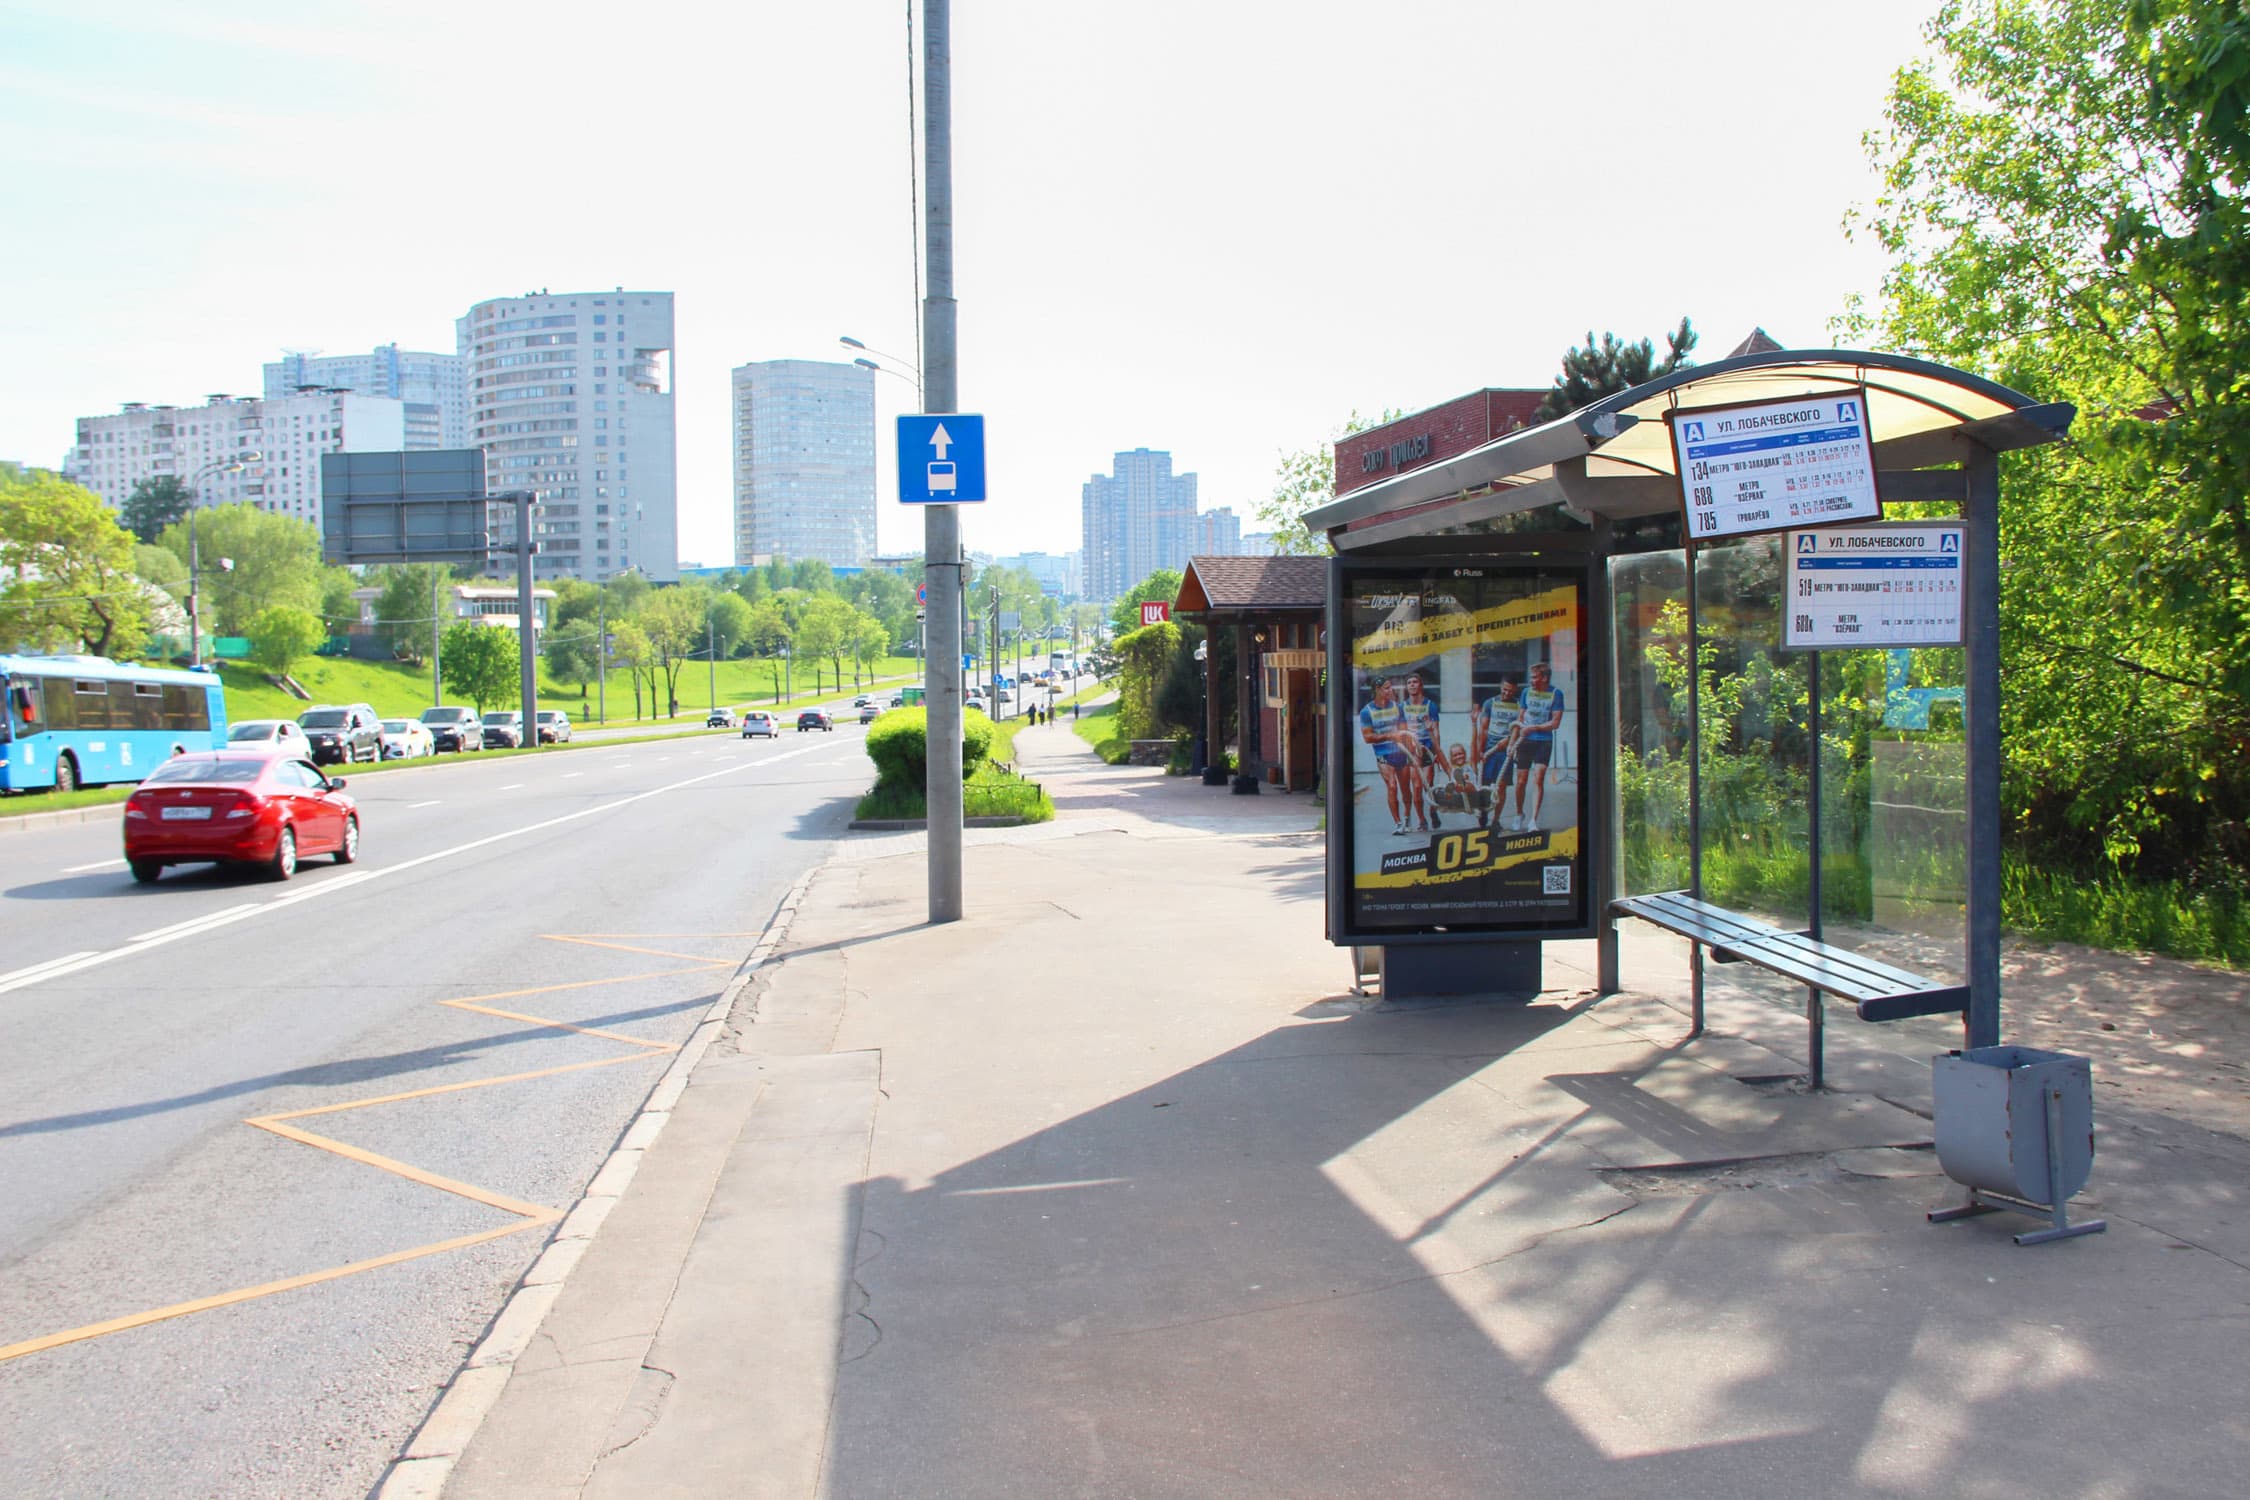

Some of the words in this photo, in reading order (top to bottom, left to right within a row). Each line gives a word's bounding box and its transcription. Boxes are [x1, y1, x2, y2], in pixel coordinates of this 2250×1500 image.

[1717, 421, 1735, 433] УЛ.
[1738, 409, 1821, 430] ЛОБАЧЕВСКОГО
[1709, 463, 1730, 475] МЕТРО
[1738, 480, 1760, 491] МЕТРО
[1694, 486, 1713, 507] 688
[1697, 511, 1717, 532] 785
[1828, 537, 1845, 548] УЛ.
[1847, 536, 1925, 548] ЛОБАЧЕВСКОГО
[1462, 569, 1483, 577] Russ
[1799, 578, 1812, 597] 519
[1814, 583, 1833, 592] МЕТРО
[1838, 614, 1857, 623] МЕТРО
[1393, 634, 1429, 650] ЯРКИЙ
[1476, 608, 1567, 633] ПРЕПЯТСТВИЯМИ
[1436, 830, 1490, 870] 05
[1505, 836, 1542, 851] ИЮНЯ
[1383, 852, 1427, 868] МОСКВА
